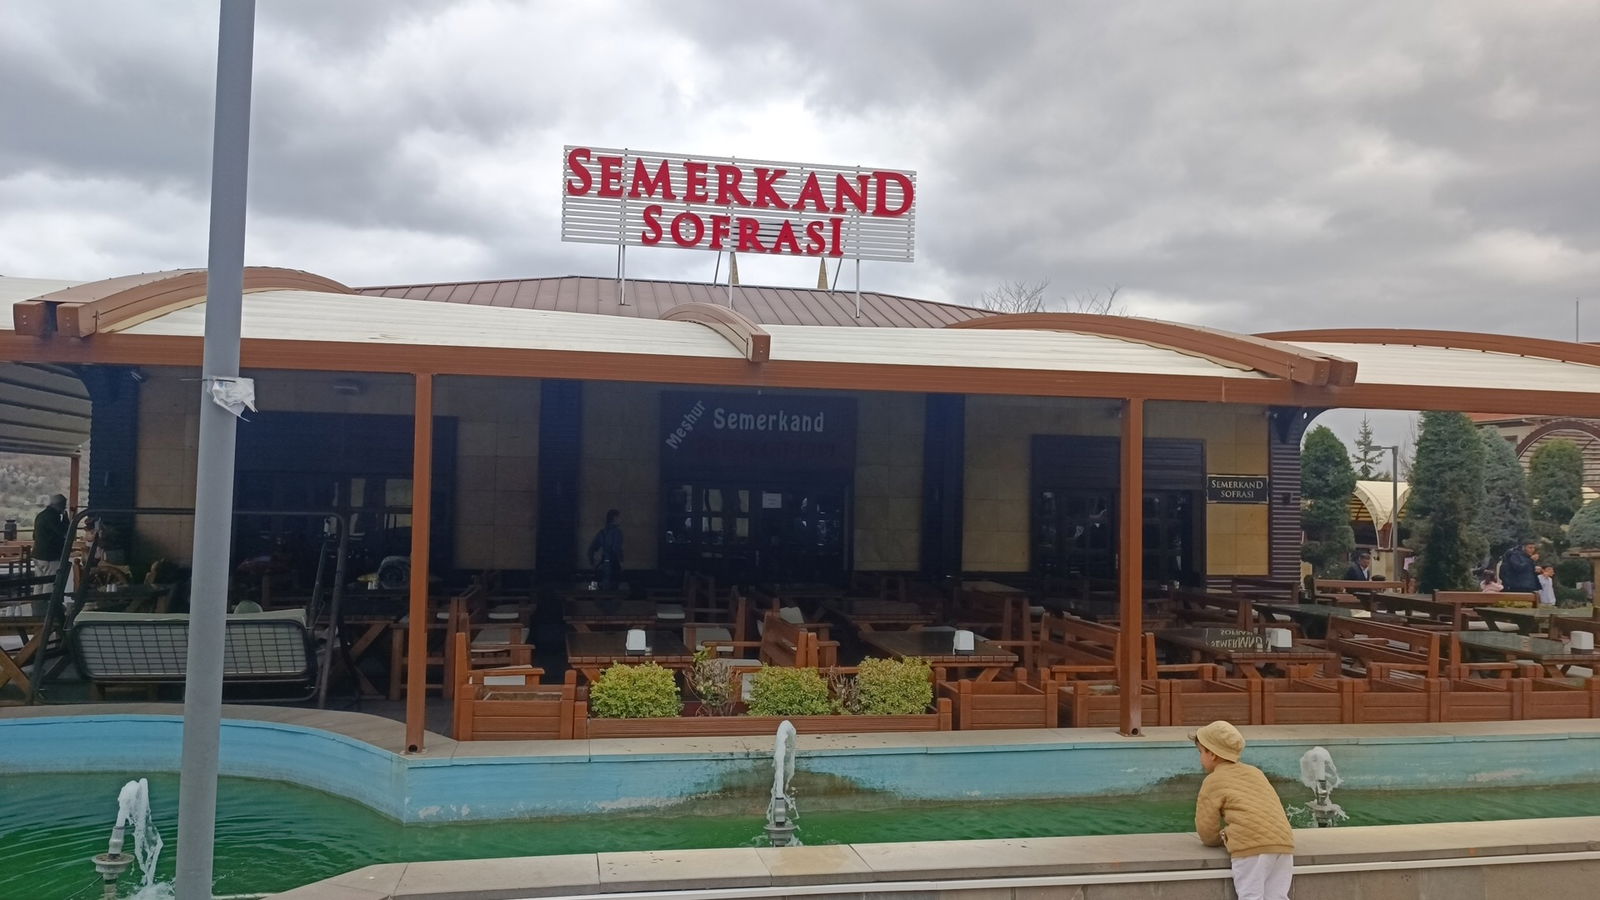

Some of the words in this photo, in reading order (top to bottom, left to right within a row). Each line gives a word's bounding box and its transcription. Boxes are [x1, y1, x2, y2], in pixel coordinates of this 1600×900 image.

[567, 147, 914, 216] SEMERKAND
[641, 205, 844, 257] SOFRASI
[665, 400, 706, 449] Meşhur
[713, 408, 824, 432] Semerkand
[1211, 480, 1264, 489] SEMERKAND
[1220, 490, 1254, 498] SOFRASI
